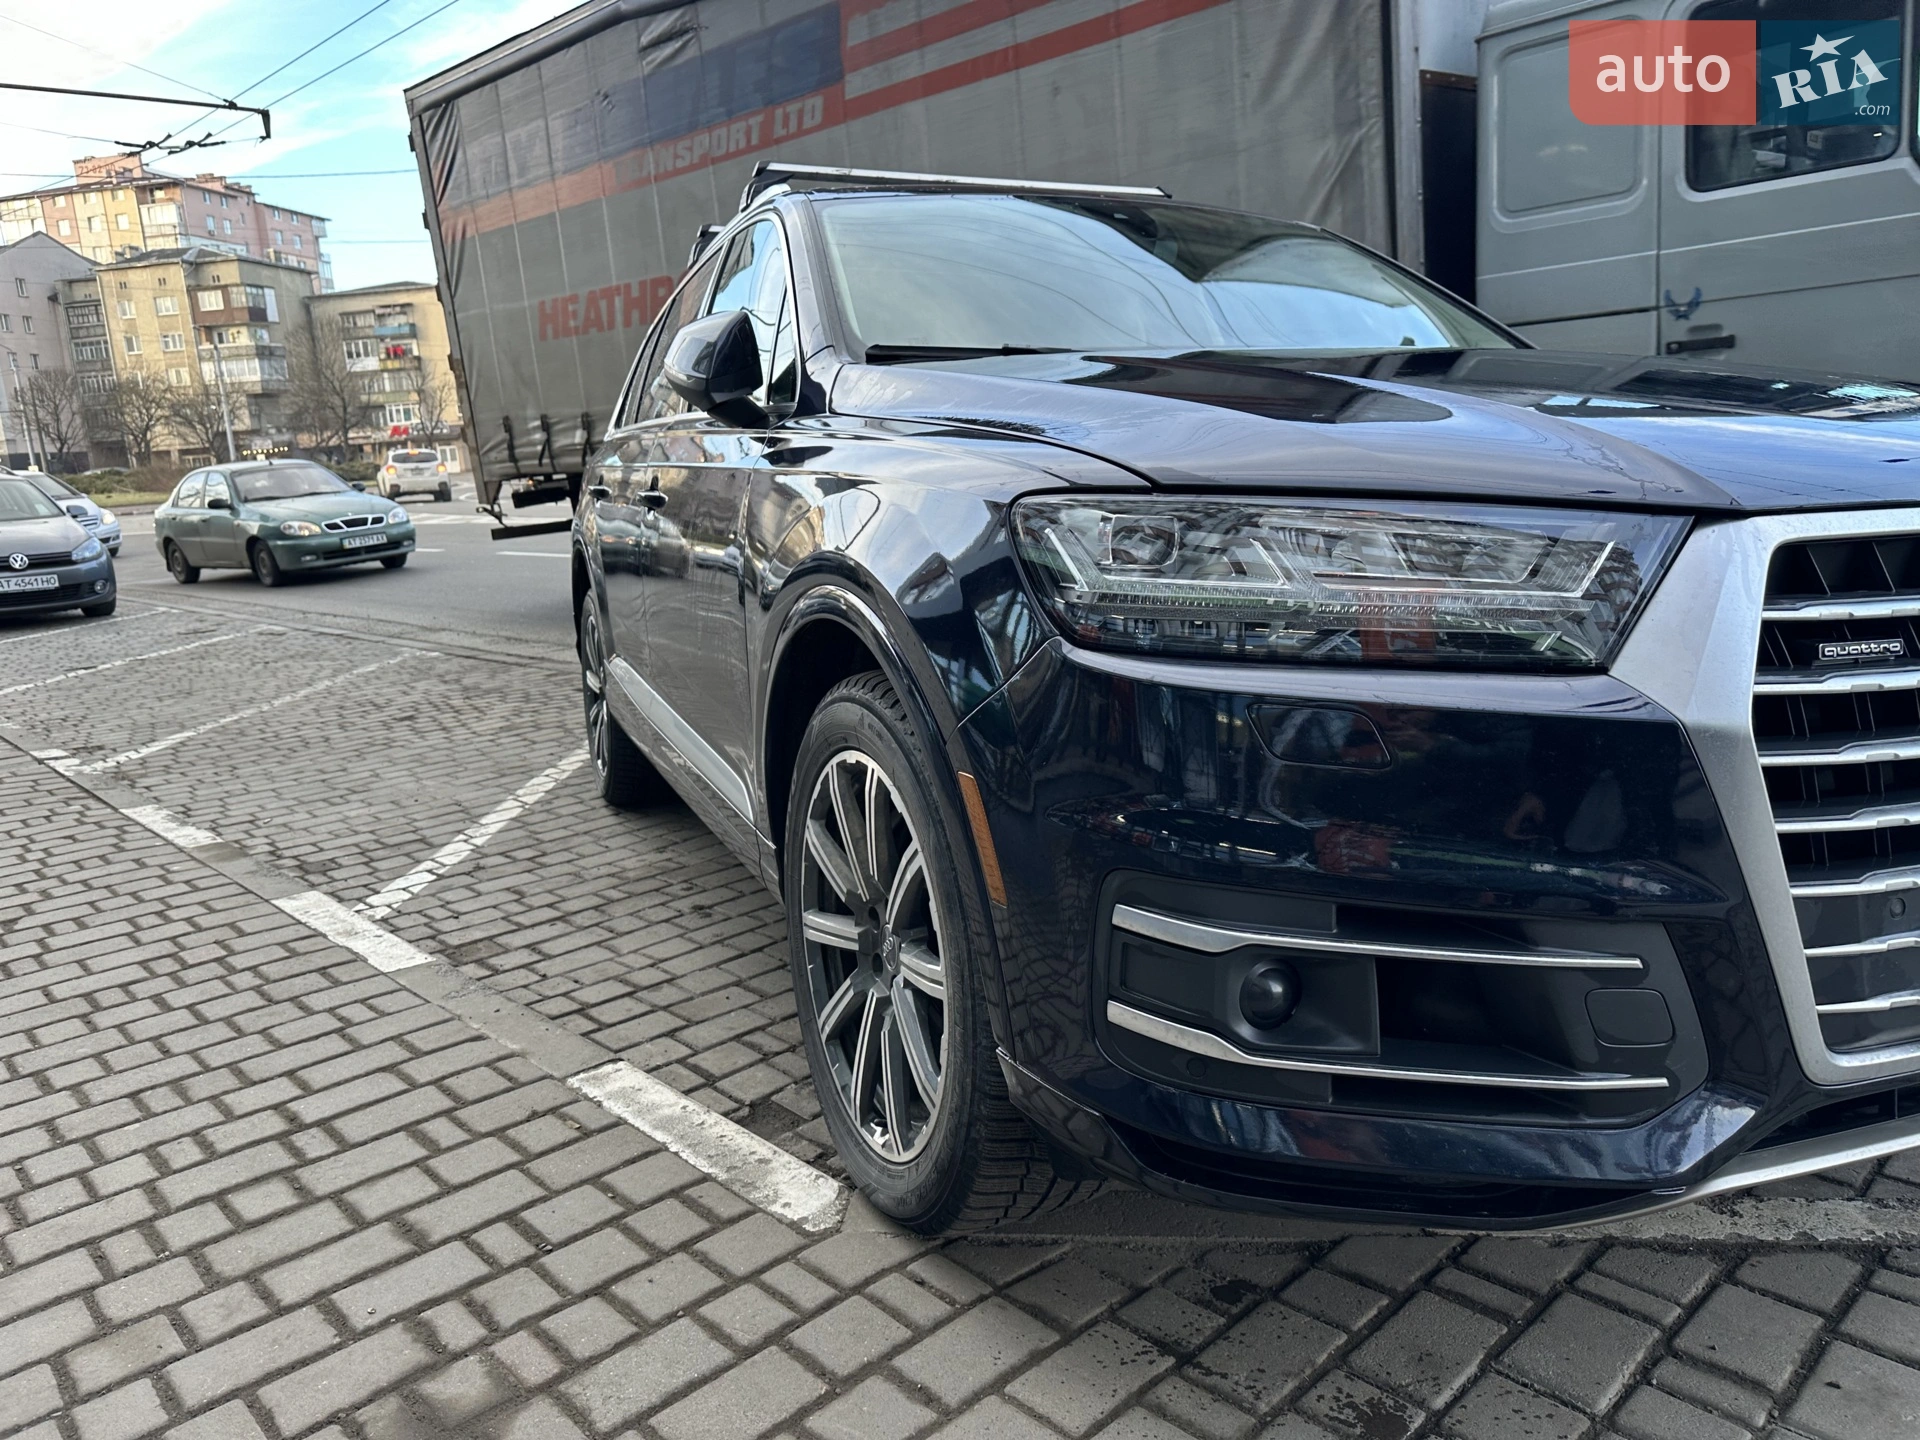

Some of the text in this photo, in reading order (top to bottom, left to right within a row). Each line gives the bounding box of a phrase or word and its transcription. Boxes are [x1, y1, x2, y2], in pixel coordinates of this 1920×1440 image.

[773, 96, 824, 139] LTD
[14, 577, 39, 588] 4541
[40, 576, 57, 586] HO
[1824, 643, 1901, 658] quattro
